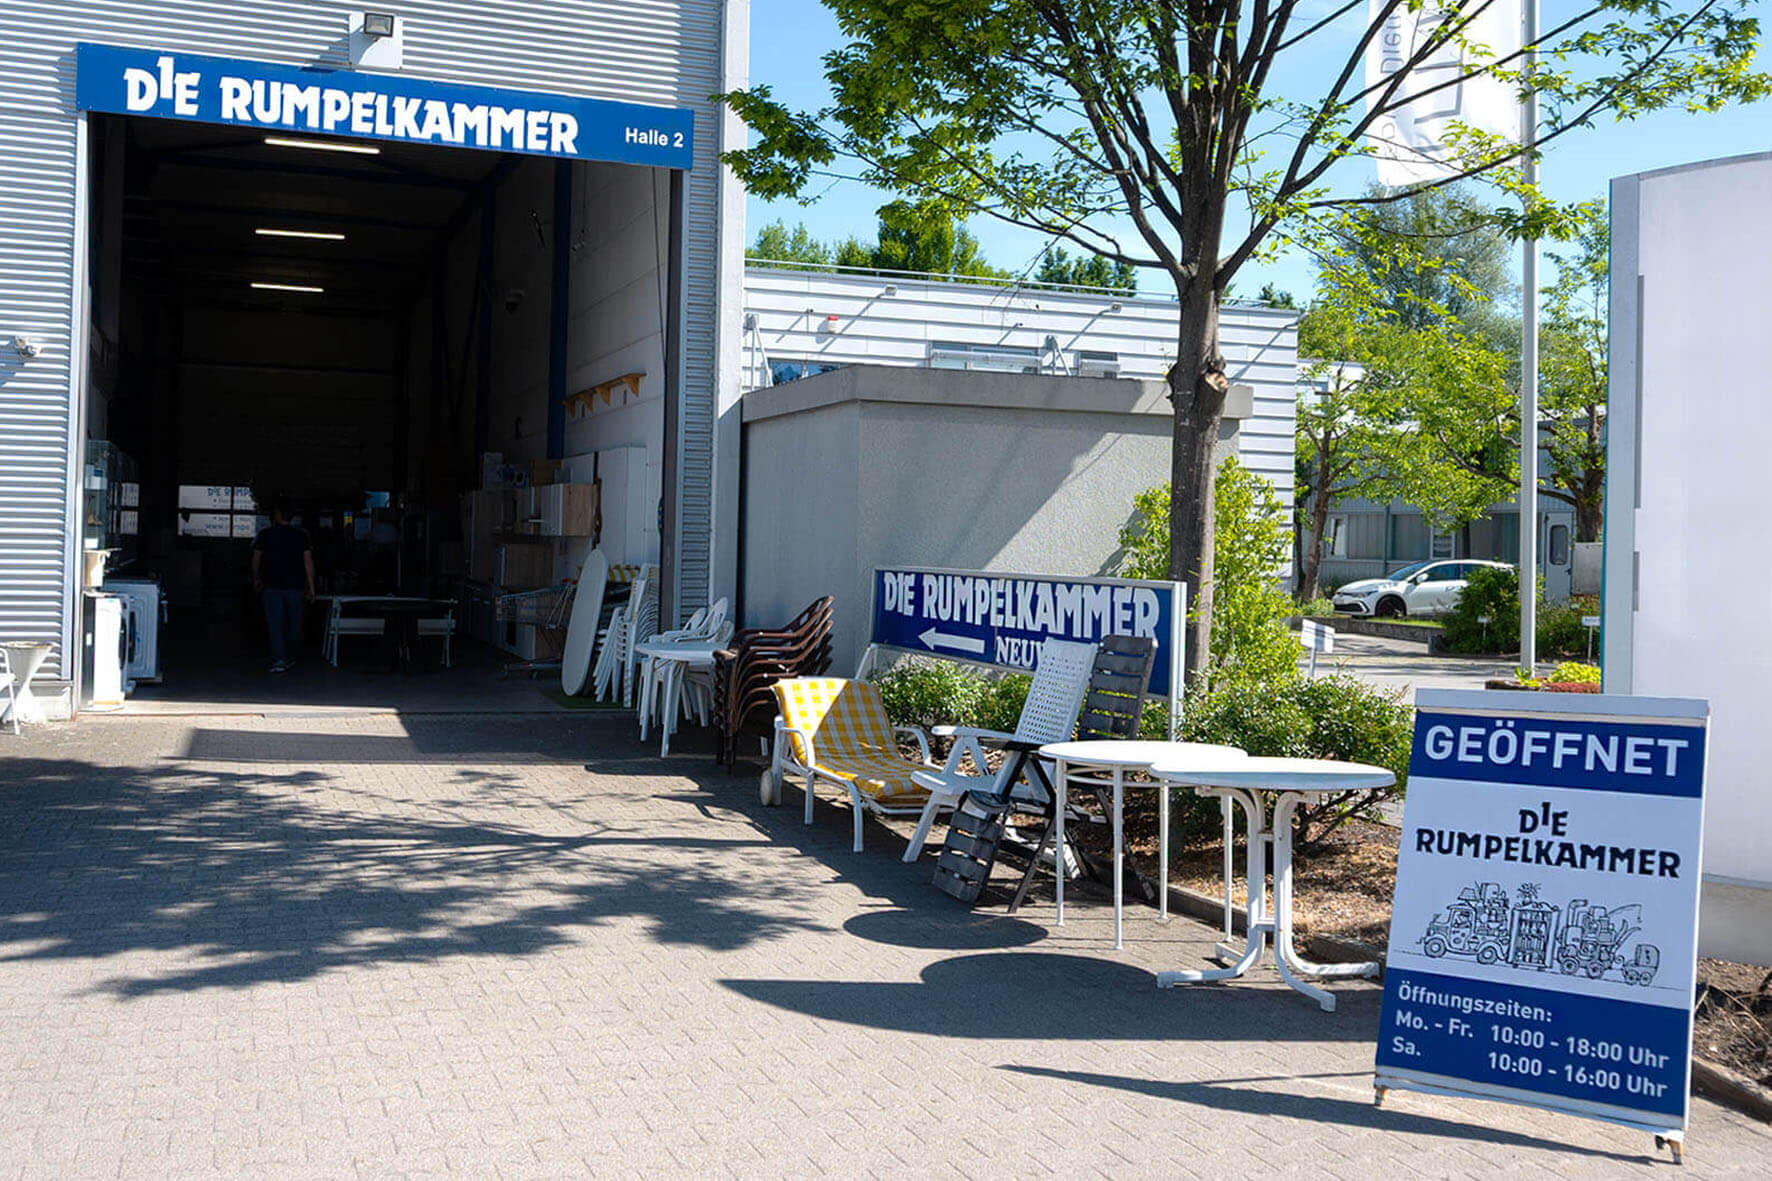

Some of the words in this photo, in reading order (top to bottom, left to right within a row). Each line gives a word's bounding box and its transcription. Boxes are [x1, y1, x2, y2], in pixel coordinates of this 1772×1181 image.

[123, 56, 201, 117] DIE
[219, 76, 579, 155] RUMPELKAMMER
[625, 127, 669, 146] Halle
[673, 132, 684, 148] 2
[883, 571, 916, 617] DIE
[922, 573, 1160, 640] RUMPELKAMMER
[996, 636, 1045, 668] NEU
[1425, 720, 1689, 777] GEÖFFNET
[1519, 802, 1569, 837] DIE
[1415, 828, 1681, 879] RUMPELKAMMER
[1398, 980, 1552, 1023] Öffnungszeiten:
[1392, 1037, 1422, 1057] Sa.
[1488, 1051, 1543, 1077] 10:00
[1563, 1065, 1621, 1090] 16:00
[1626, 1074, 1668, 1098] Uhr
[1395, 1010, 1429, 1031] Mo.
[1448, 1020, 1474, 1038] Fr.
[1490, 1024, 1545, 1049] 10:00
[1566, 1036, 1622, 1062] 18:00
[1628, 1046, 1670, 1069] Uhr
